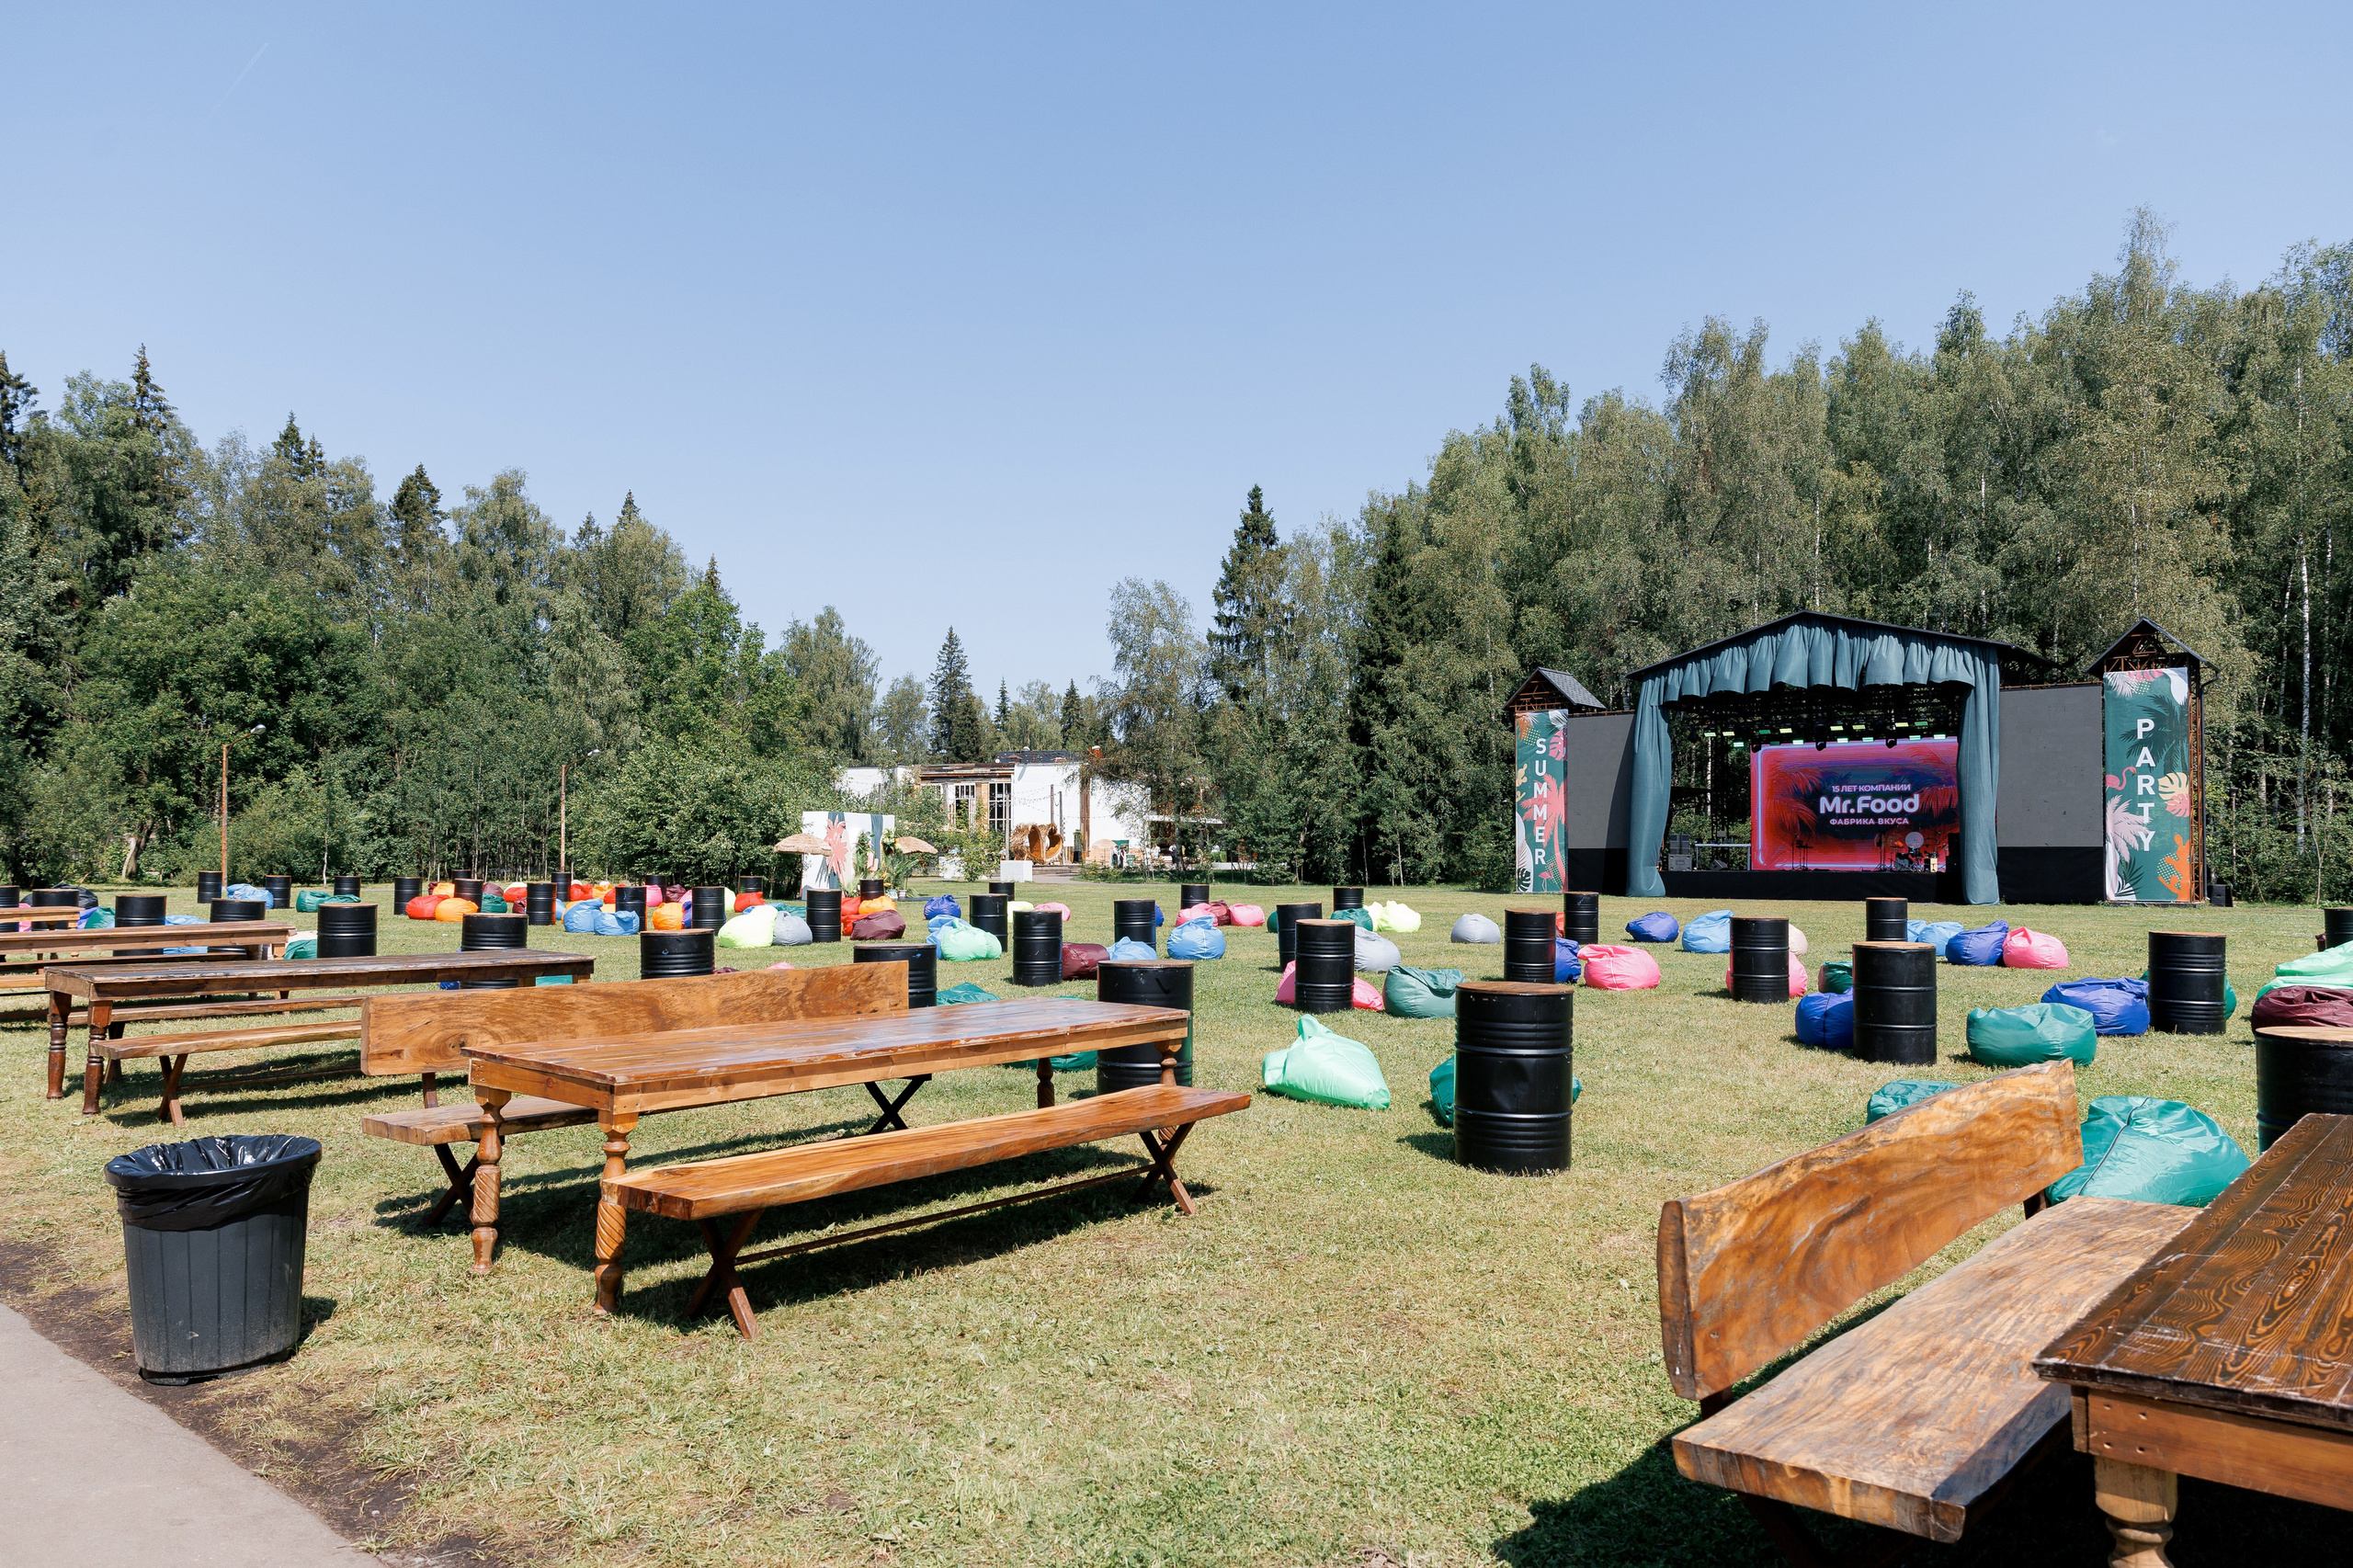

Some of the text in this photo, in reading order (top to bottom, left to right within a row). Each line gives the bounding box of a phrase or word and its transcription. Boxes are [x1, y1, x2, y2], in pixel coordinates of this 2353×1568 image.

[1533, 737, 1548, 865] SUMMER
[1820, 793, 1919, 813] Mr.Food
[2135, 718, 2155, 852] PARTY
